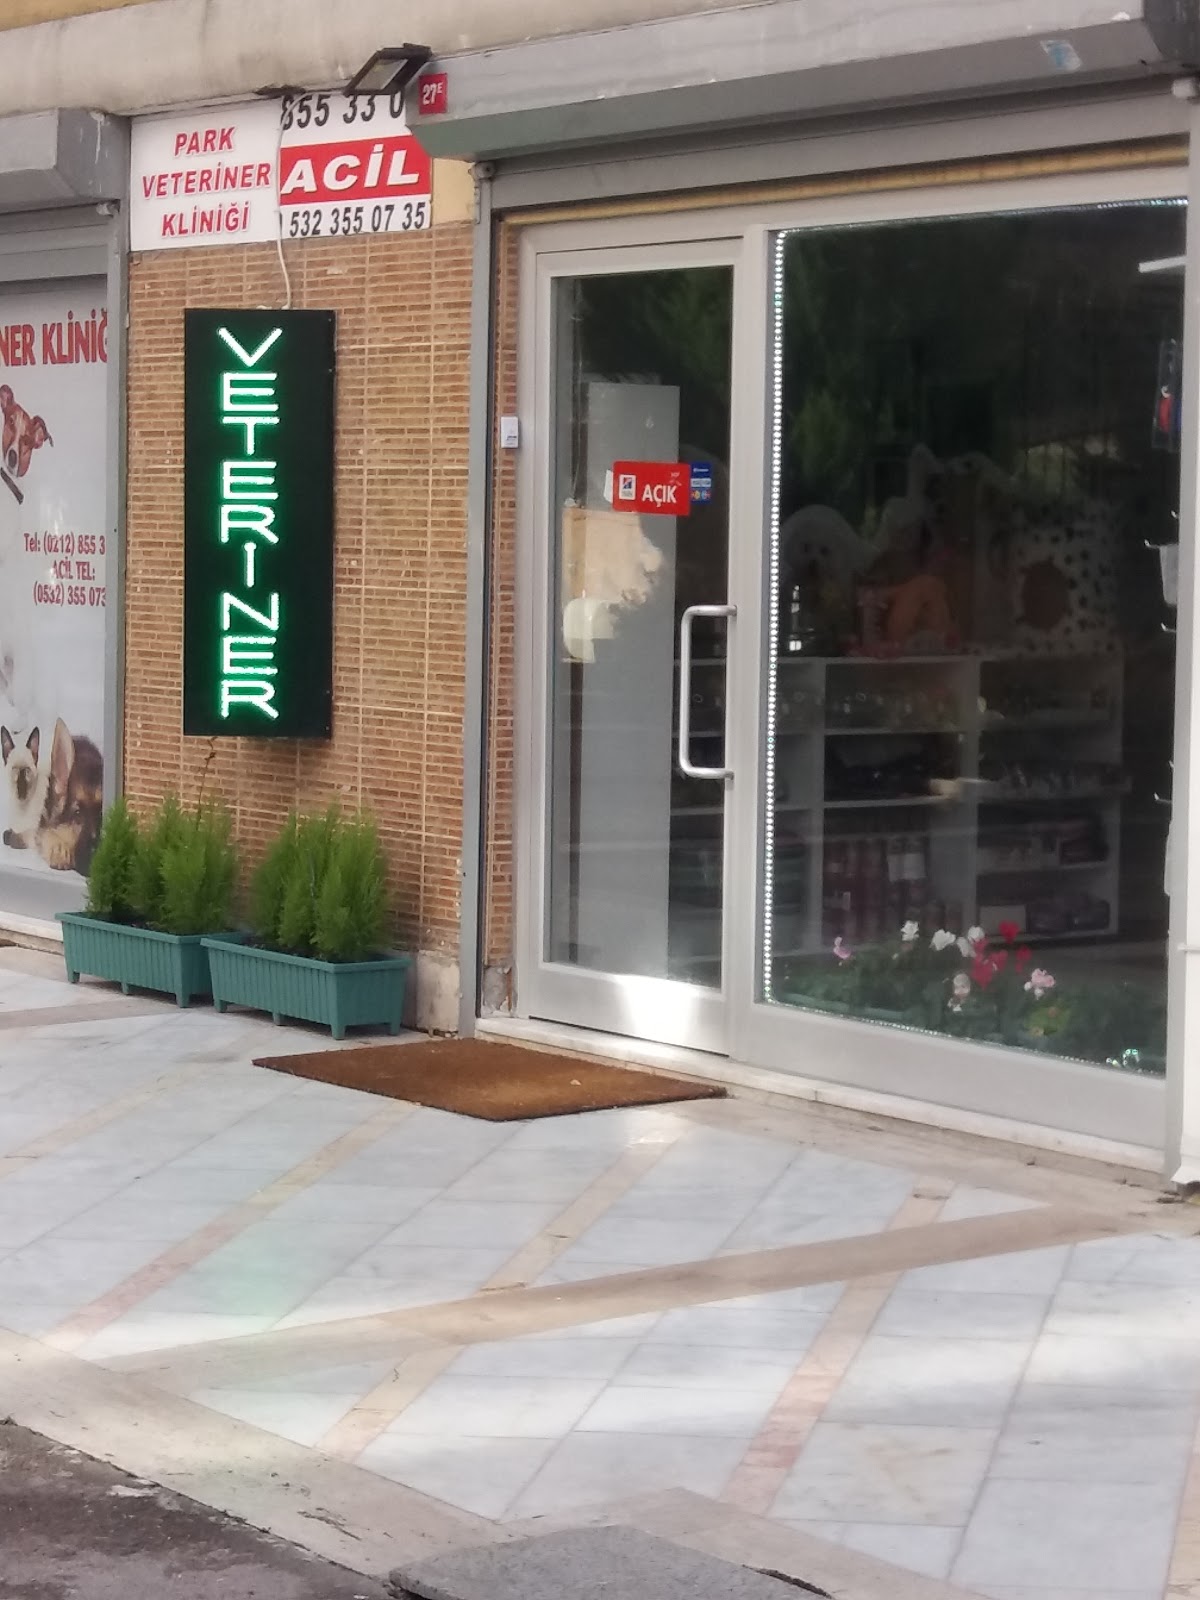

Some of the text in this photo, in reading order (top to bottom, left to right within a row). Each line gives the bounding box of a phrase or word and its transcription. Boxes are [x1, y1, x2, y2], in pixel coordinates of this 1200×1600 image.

[174, 127, 235, 156] PARK
[142, 161, 272, 199] VETERİNER
[280, 143, 420, 195] ACİL
[161, 200, 250, 238] KLİNİĞİ
[290, 209, 322, 237] 532
[330, 206, 364, 236] 355
[371, 204, 395, 232] 07
[402, 201, 426, 230] 35
[642, 484, 677, 507] AÇIK
[24, 532, 41, 552] Tel:
[43, 530, 75, 556] (0212)
[78, 534, 96, 555] 855
[75, 561, 95, 581] TEL:
[34, 581, 64, 607] (0532)
[67, 585, 86, 606] 355
